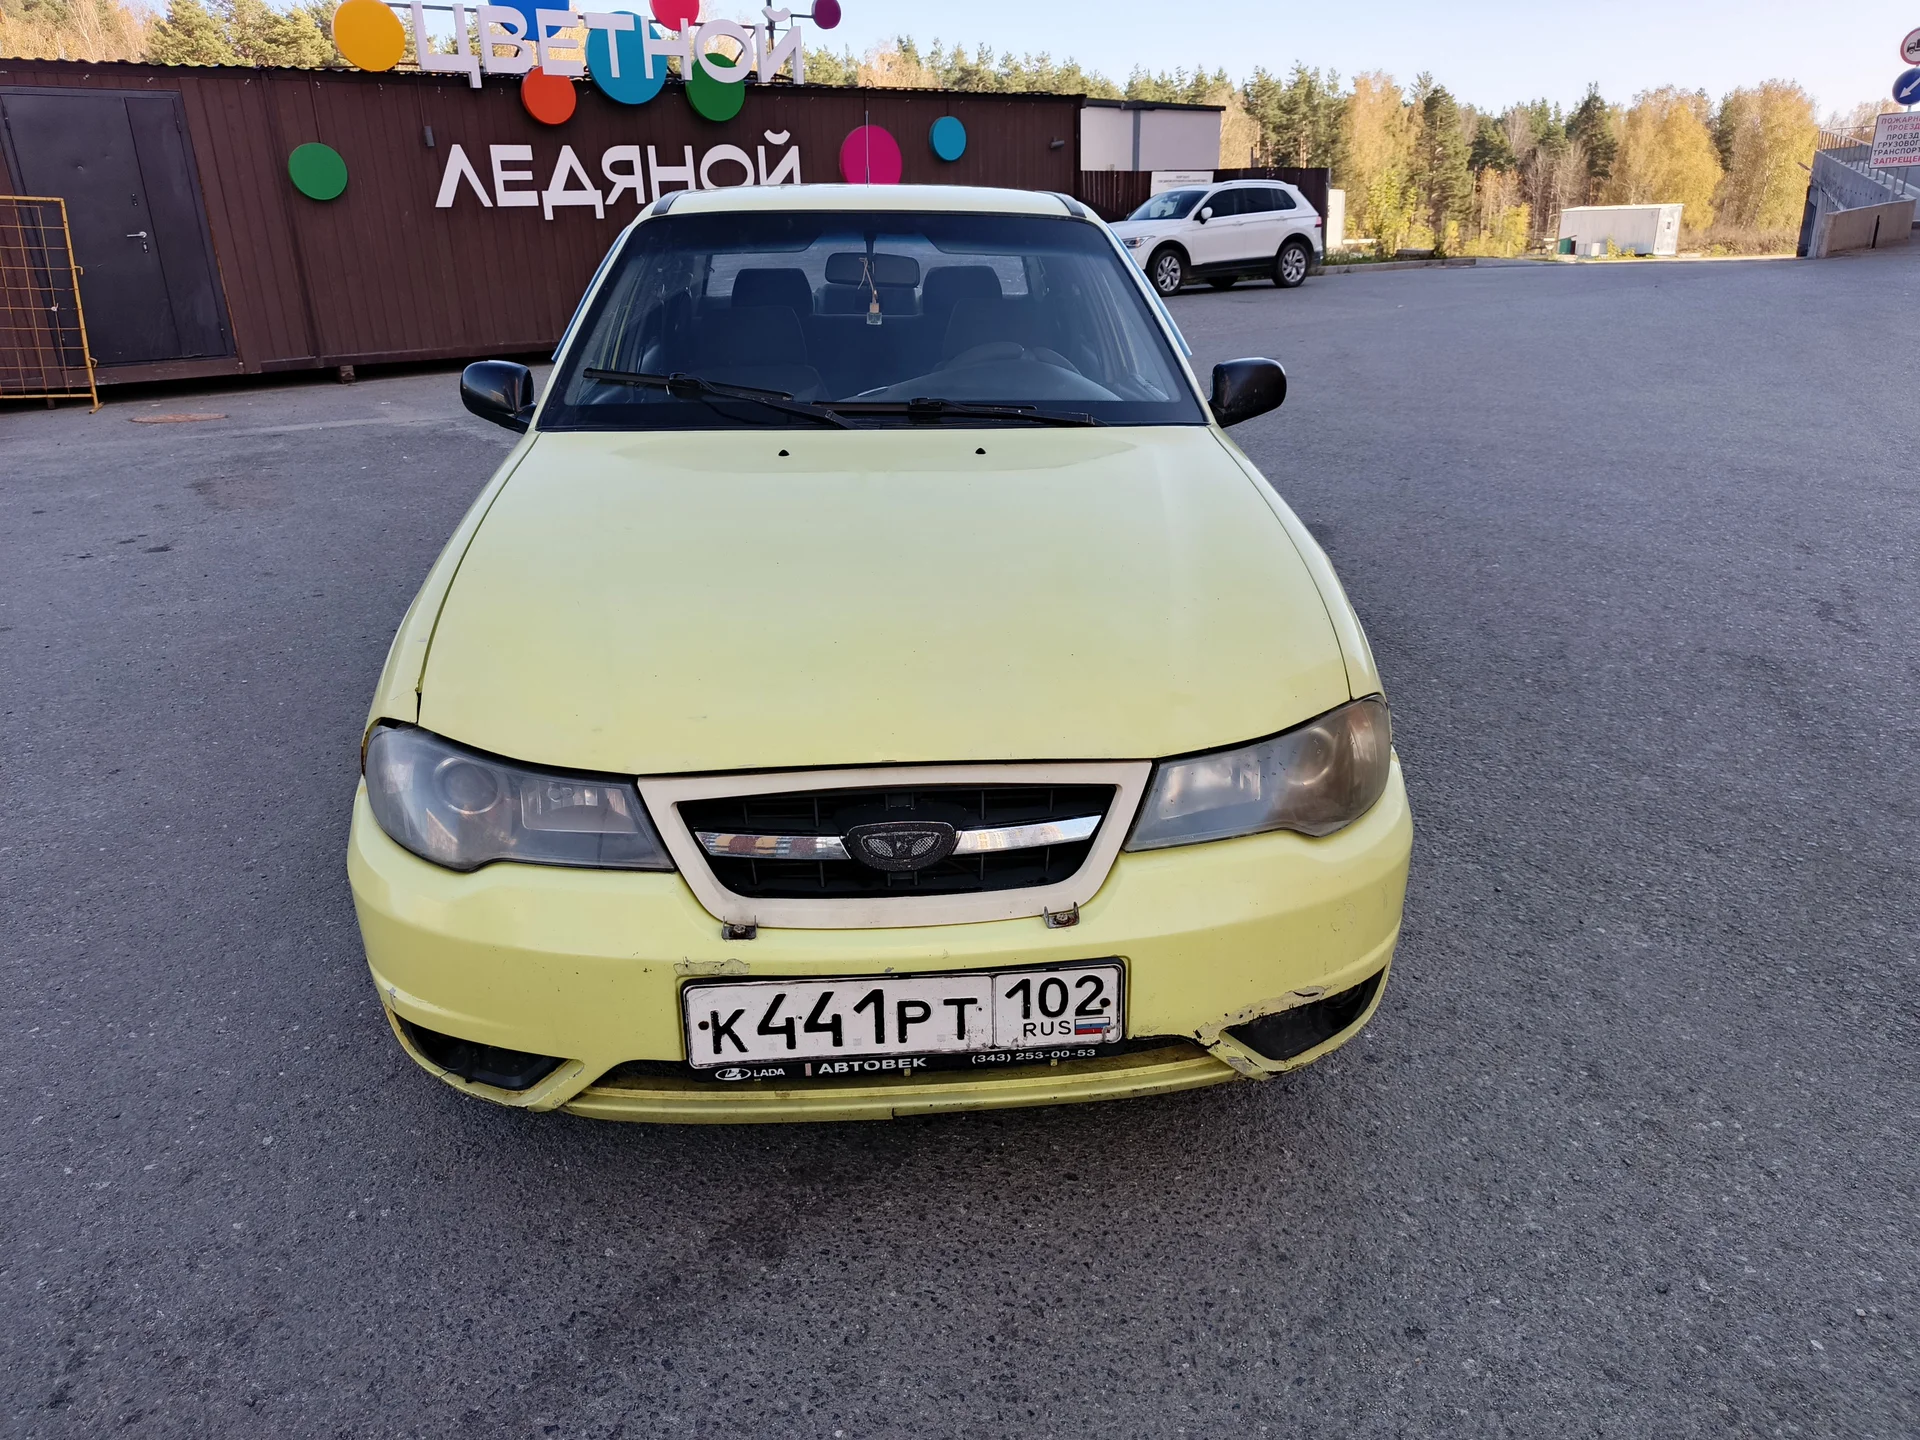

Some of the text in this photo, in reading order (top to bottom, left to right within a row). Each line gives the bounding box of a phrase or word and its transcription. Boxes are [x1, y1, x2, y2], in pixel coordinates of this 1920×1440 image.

[411, 1, 805, 89] ЦВЕТНОЙ
[1881, 115, 1920, 124] ПОЖАРН
[1887, 123, 1920, 131] ПРОЕЗД
[1886, 132, 1919, 140] ПРОЕЗД
[435, 129, 802, 221] ЛЕДЯНОЙ
[1004, 974, 1105, 1019] 102
[1022, 1020, 1072, 1038] RUS
[971, 1049, 1096, 1065] (343) 253-00-53
[753, 1067, 786, 1078] LADA
[818, 1057, 927, 1075] АВТОВЕК
